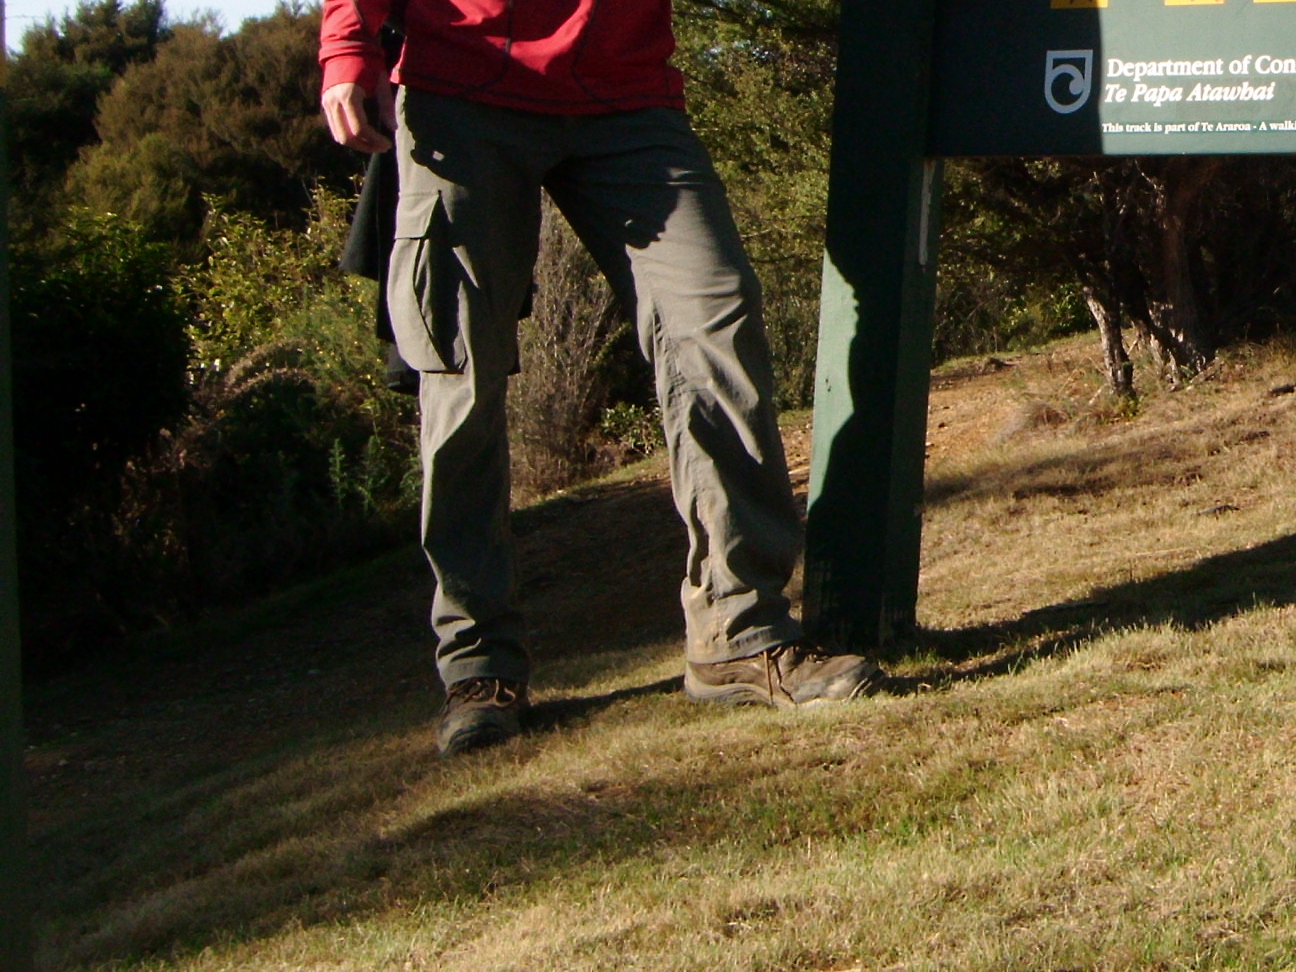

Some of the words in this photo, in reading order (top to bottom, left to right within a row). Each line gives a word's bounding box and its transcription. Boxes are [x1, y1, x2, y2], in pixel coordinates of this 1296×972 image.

[1107, 58, 1224, 81] Department
[1228, 55, 1252, 74] of
[1104, 84, 1127, 102] Te
[1131, 83, 1183, 107] Papa
[1186, 81, 1276, 102] Atawhai
[1103, 122, 1124, 133] This
[1126, 122, 1151, 133] track
[1153, 122, 1163, 132] is
[1165, 123, 1186, 134] part
[1188, 121, 1200, 132] of
[1201, 121, 1213, 132] Te
[1215, 122, 1251, 132] Araroa
[1259, 121, 1267, 131] A
